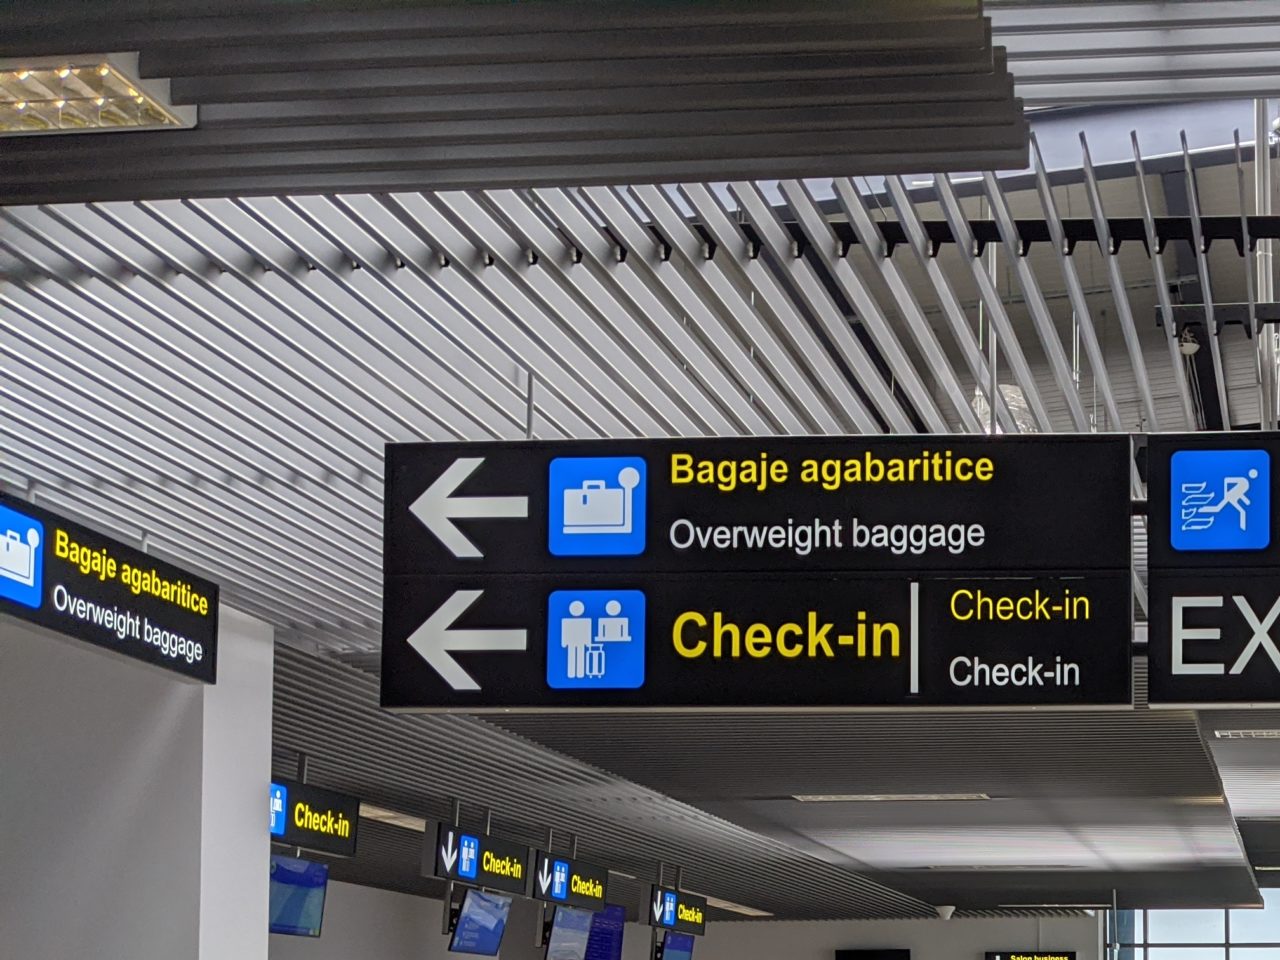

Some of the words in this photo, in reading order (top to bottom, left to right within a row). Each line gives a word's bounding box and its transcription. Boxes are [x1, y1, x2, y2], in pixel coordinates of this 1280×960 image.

[671, 454, 789, 491] Bagaje
[801, 452, 994, 489] agabaritice
[669, 518, 843, 553] Overweight
[853, 518, 985, 554] baggage
[55, 529, 117, 580] Bagaje
[121, 563, 208, 615] agabaritice
[950, 589, 1090, 621] Check-in
[54, 585, 140, 639] Overweight
[144, 618, 203, 663] baggage
[672, 610, 901, 659] Check-in
[949, 656, 1080, 687] Check-in
[294, 802, 350, 838] Check-in
[483, 851, 522, 879] Check-in
[571, 874, 603, 898] Check-in
[677, 904, 703, 924] Check-in
